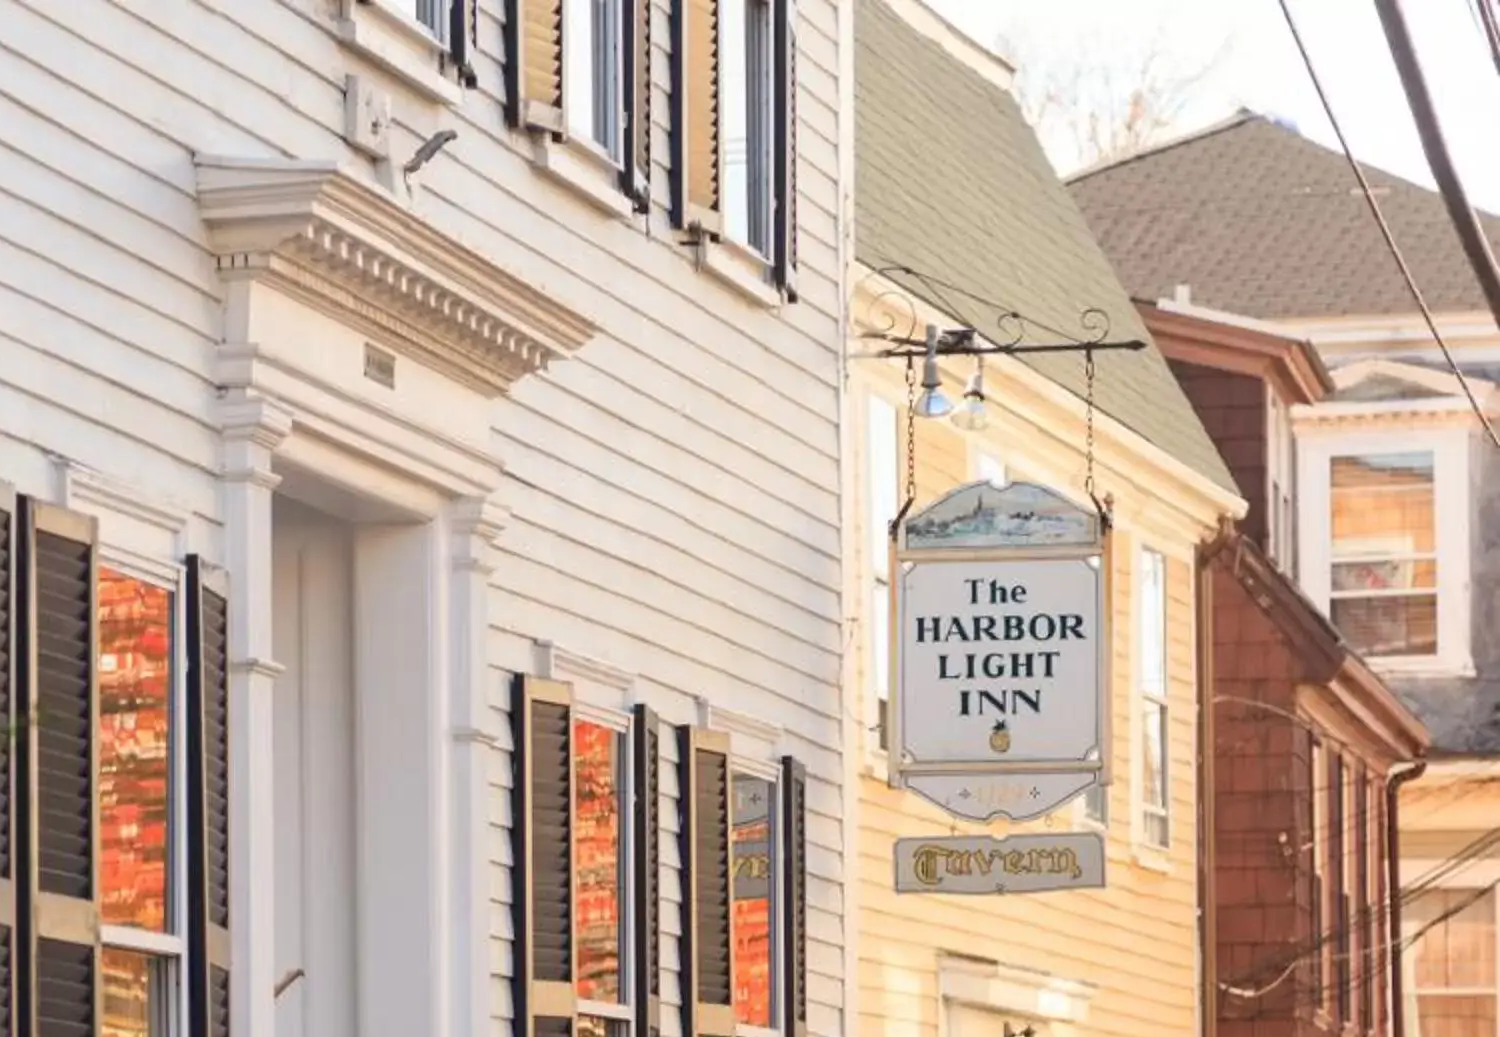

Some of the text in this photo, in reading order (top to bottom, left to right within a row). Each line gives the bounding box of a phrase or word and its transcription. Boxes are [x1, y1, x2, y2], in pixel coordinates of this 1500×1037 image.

[964, 578, 1027, 605] The
[915, 614, 1086, 643] HARBOR
[938, 650, 1061, 680] LIGHT
[959, 690, 1041, 716] INN
[912, 844, 1083, 886] Tavern
